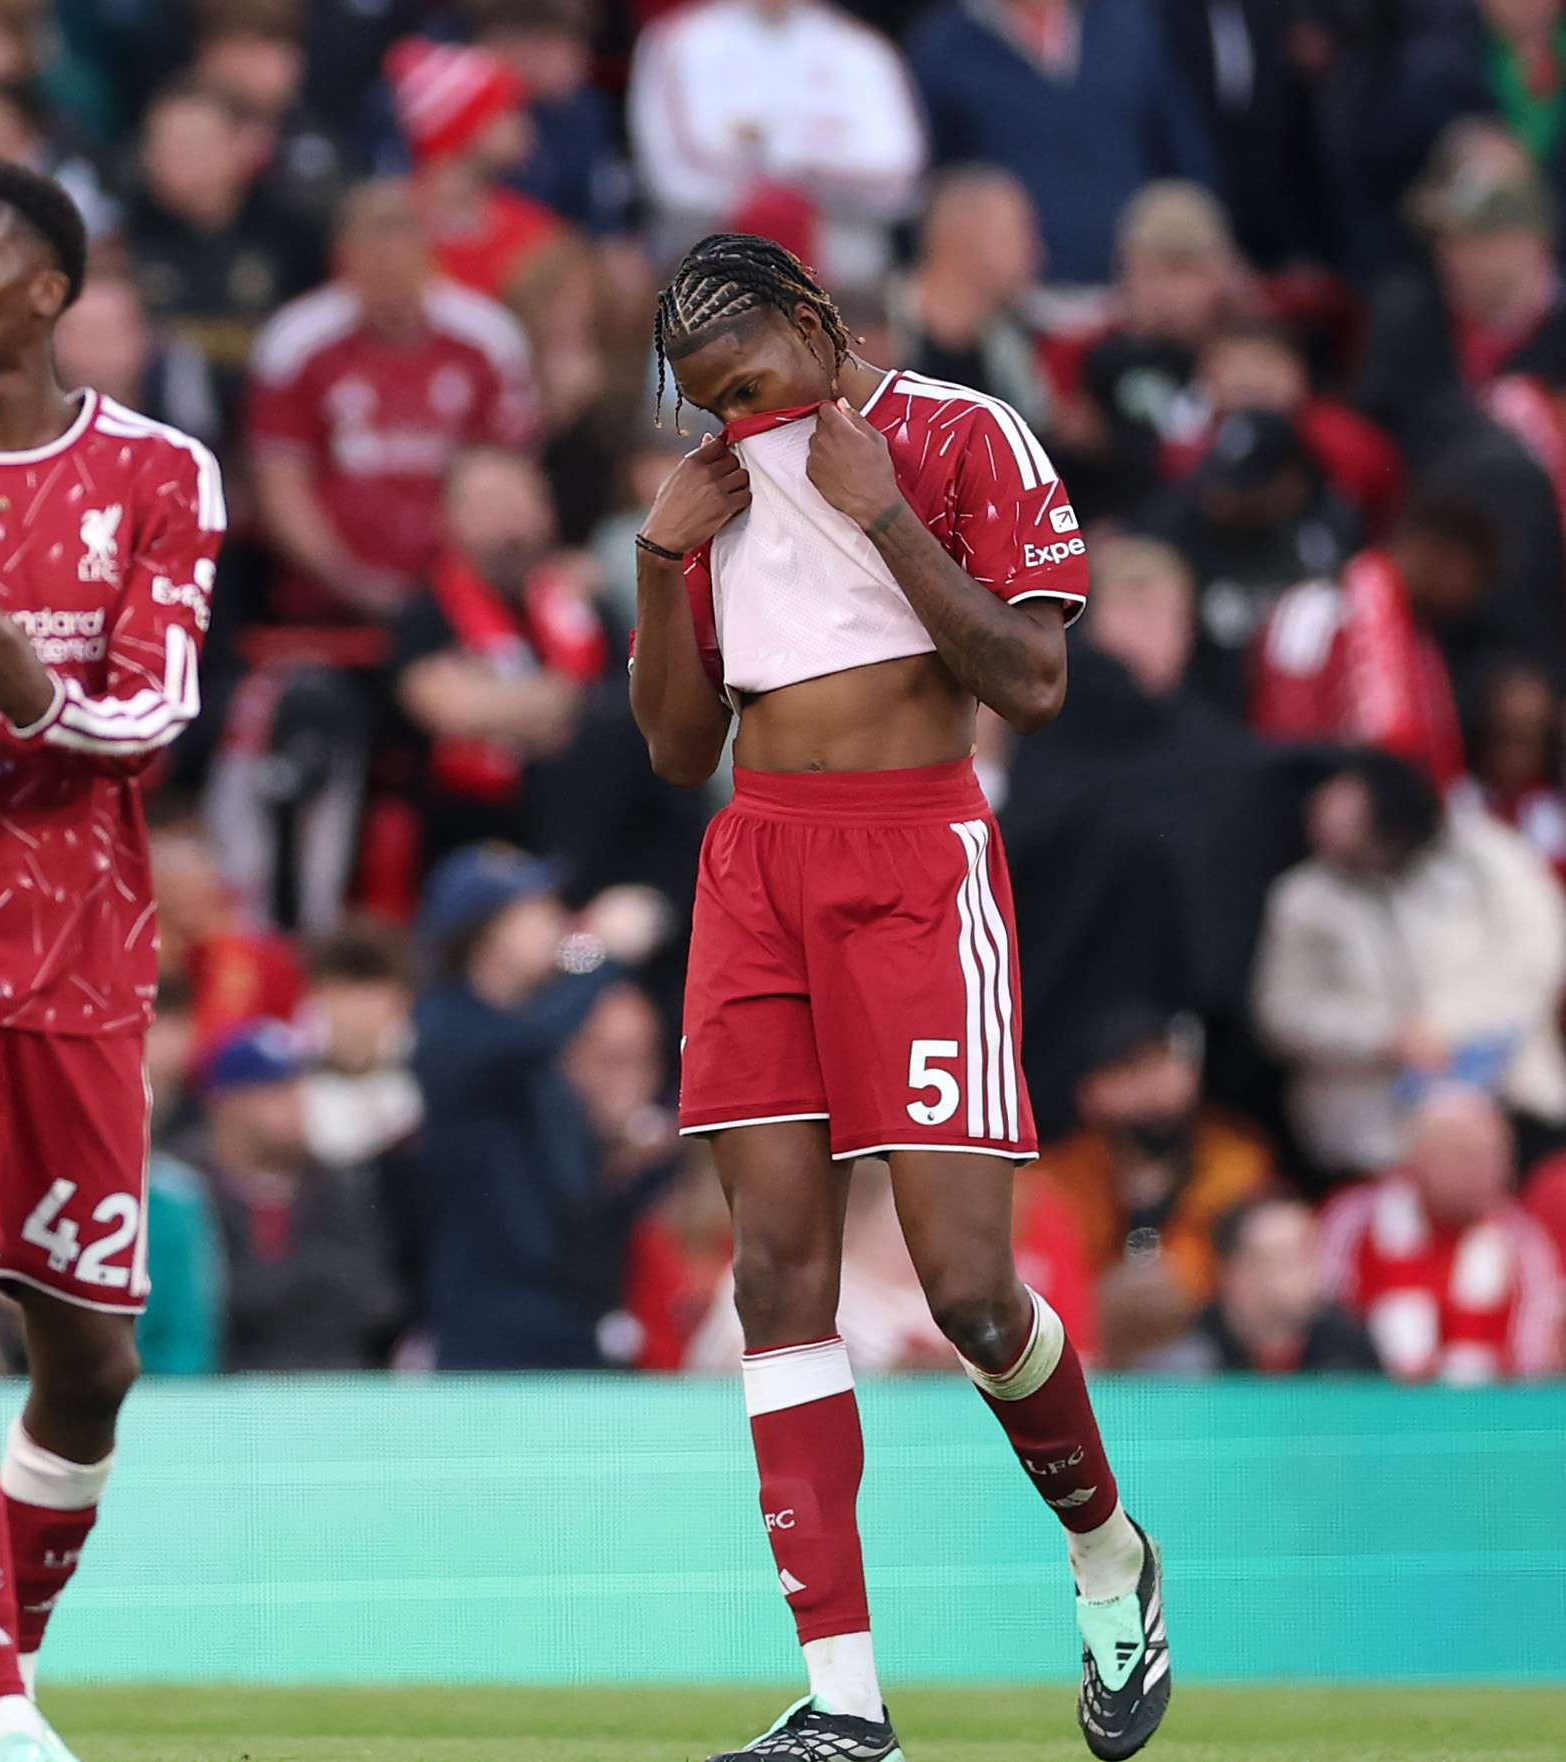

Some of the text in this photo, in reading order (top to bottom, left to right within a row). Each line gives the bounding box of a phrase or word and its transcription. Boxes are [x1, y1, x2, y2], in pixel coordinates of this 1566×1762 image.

[1024, 538, 1086, 567] Expe
[12, 608, 105, 637] ndard
[906, 1040, 960, 1125] 5
[21, 1178, 139, 1287] 42
[1026, 1445, 1084, 1475] LFC
[765, 1509, 795, 1532] FC
[44, 1550, 79, 1568] LF
